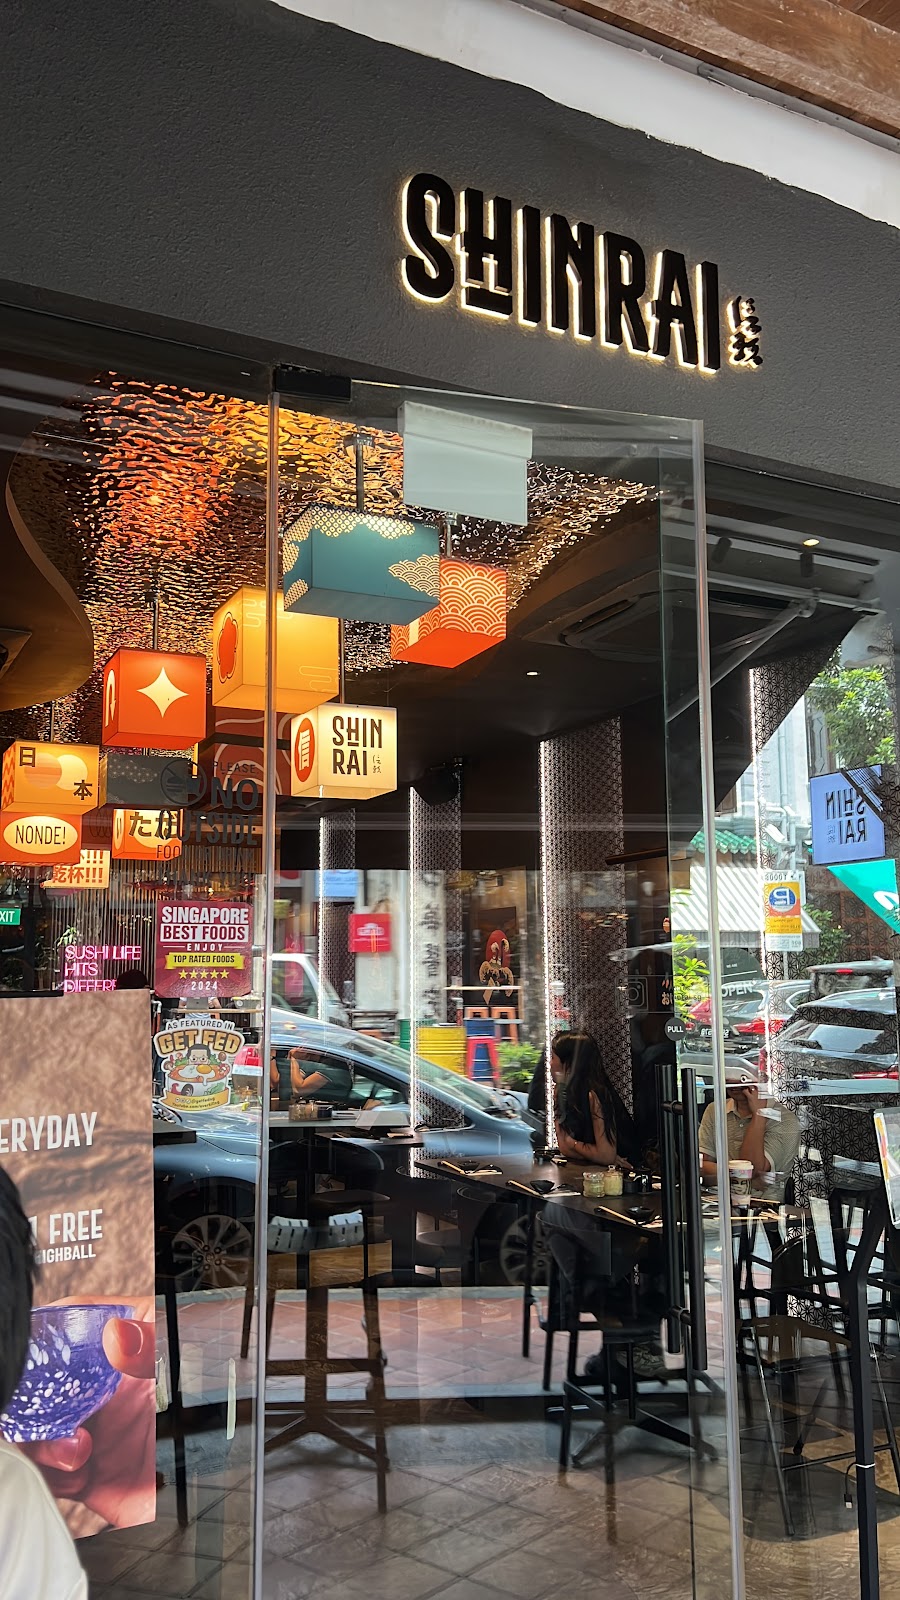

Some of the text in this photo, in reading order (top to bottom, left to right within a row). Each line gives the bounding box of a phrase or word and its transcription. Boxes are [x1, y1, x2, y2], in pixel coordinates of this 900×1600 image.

[402, 173, 721, 373] SHINRAI
[332, 715, 382, 748] SHIN
[19, 746, 36, 768] 日
[332, 748, 367, 776] RAI
[213, 760, 257, 774] PLEASE
[73, 779, 93, 801] 本
[210, 776, 259, 811] NO
[15, 825, 66, 845] NONDE!
[159, 808, 258, 846] OUTSIDE
[156, 845, 190, 860] FOO
[161, 906, 249, 925] SINGAPORE
[163, 925, 246, 941] BEST FOODS
[65, 944, 142, 960] SUSHI LIFE
[186, 943, 223, 951] ENJOY
[173, 955, 235, 963] TOP RATED FOODS
[64, 962, 98, 977] HITS
[191, 981, 218, 991] 2024
[167, 1019, 234, 1030] AS FEATURED IN
[667, 1025, 684, 1033] PULL
[157, 1028, 243, 1055] GET FED
[49, 1208, 103, 1245] FREE
